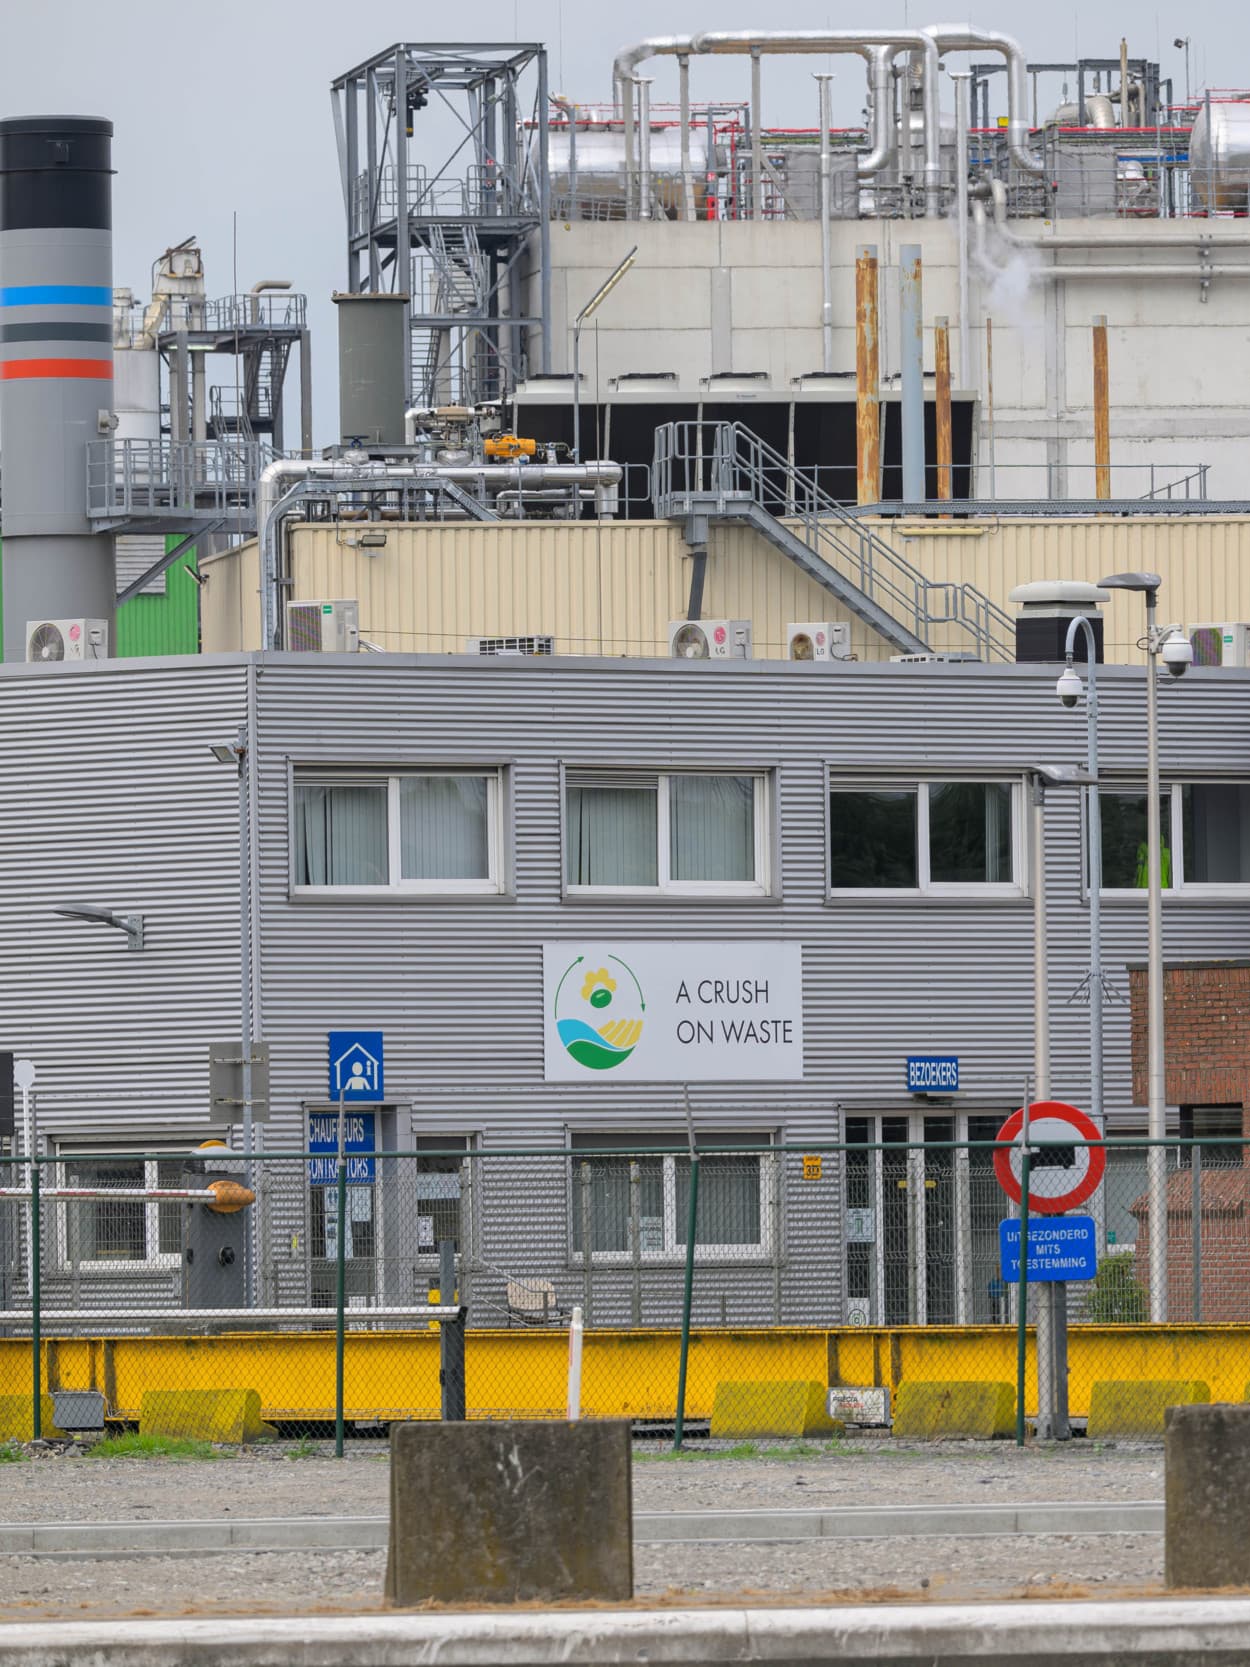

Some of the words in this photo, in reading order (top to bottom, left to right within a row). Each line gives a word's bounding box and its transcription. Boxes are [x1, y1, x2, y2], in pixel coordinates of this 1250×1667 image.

[676, 979, 691, 1004] A
[698, 979, 769, 1004] CRUSH
[677, 1020, 714, 1044] ON
[721, 1020, 793, 1044] WASTE
[910, 1061, 957, 1086] BEZOEKERS
[308, 1157, 368, 1178] ONTRATORS
[1036, 1244, 1061, 1255] MITS
